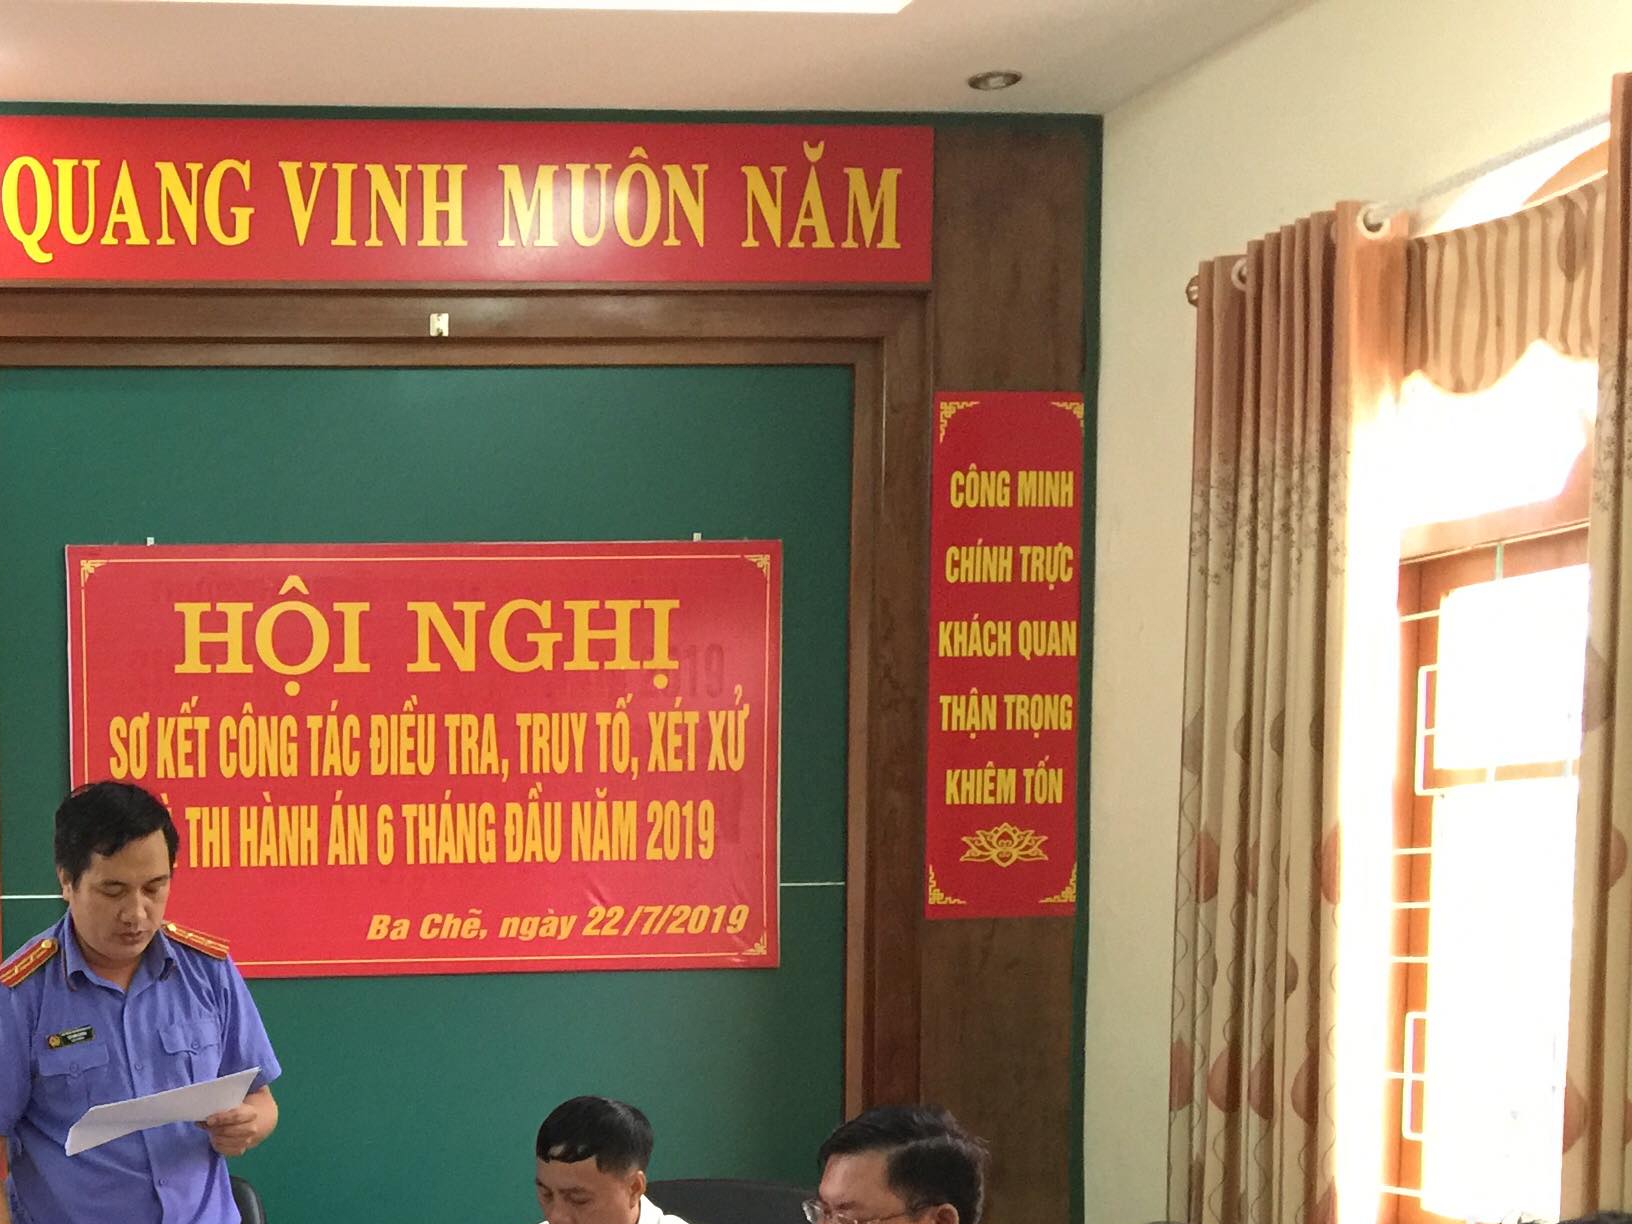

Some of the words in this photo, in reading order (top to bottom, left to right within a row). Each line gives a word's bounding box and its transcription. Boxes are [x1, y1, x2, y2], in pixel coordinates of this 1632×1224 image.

[1, 156, 254, 263] QUANG
[278, 161, 468, 249] VINH
[497, 147, 708, 249] MUÔN
[741, 142, 902, 248] NĂM
[951, 463, 1011, 509] CÔNG
[1018, 471, 1073, 507] MINH
[945, 539, 1012, 583] CHÍNH
[1020, 542, 1073, 590] TRỰC
[175, 576, 370, 696] HỘI
[407, 599, 679, 688] NGHỊ
[939, 614, 1011, 656] KHÁCH
[1019, 621, 1076, 660] QUAN
[110, 712, 149, 779] SƠ
[157, 696, 210, 778] KẾT
[219, 703, 297, 778] CÔNG
[307, 701, 360, 776] TÁC
[369, 695, 435, 775] ĐIỀU
[445, 713, 508, 782] TRA,
[516, 712, 587, 774] TRUY
[596, 694, 639, 780] TỐ,
[648, 698, 699, 771] XÉT
[708, 684, 751, 772] XỬ
[940, 688, 996, 738] THẬN
[1004, 694, 1073, 738] TRỌNG
[946, 761, 1017, 805] KHIÊM
[1023, 755, 1062, 804] TỐN
[185, 807, 230, 867] THI
[240, 793, 318, 867] HÀNH
[328, 790, 367, 865] ÁN
[377, 805, 394, 865] 6
[402, 790, 496, 864] THÁNG
[504, 783, 562, 863] ĐẦU
[572, 790, 637, 861] NĂM
[646, 800, 714, 860] 2019
[367, 914, 411, 941] Ba
[419, 908, 486, 941] Chẽ,
[500, 907, 577, 942] ngày
[583, 904, 750, 937] 22/7/2019
